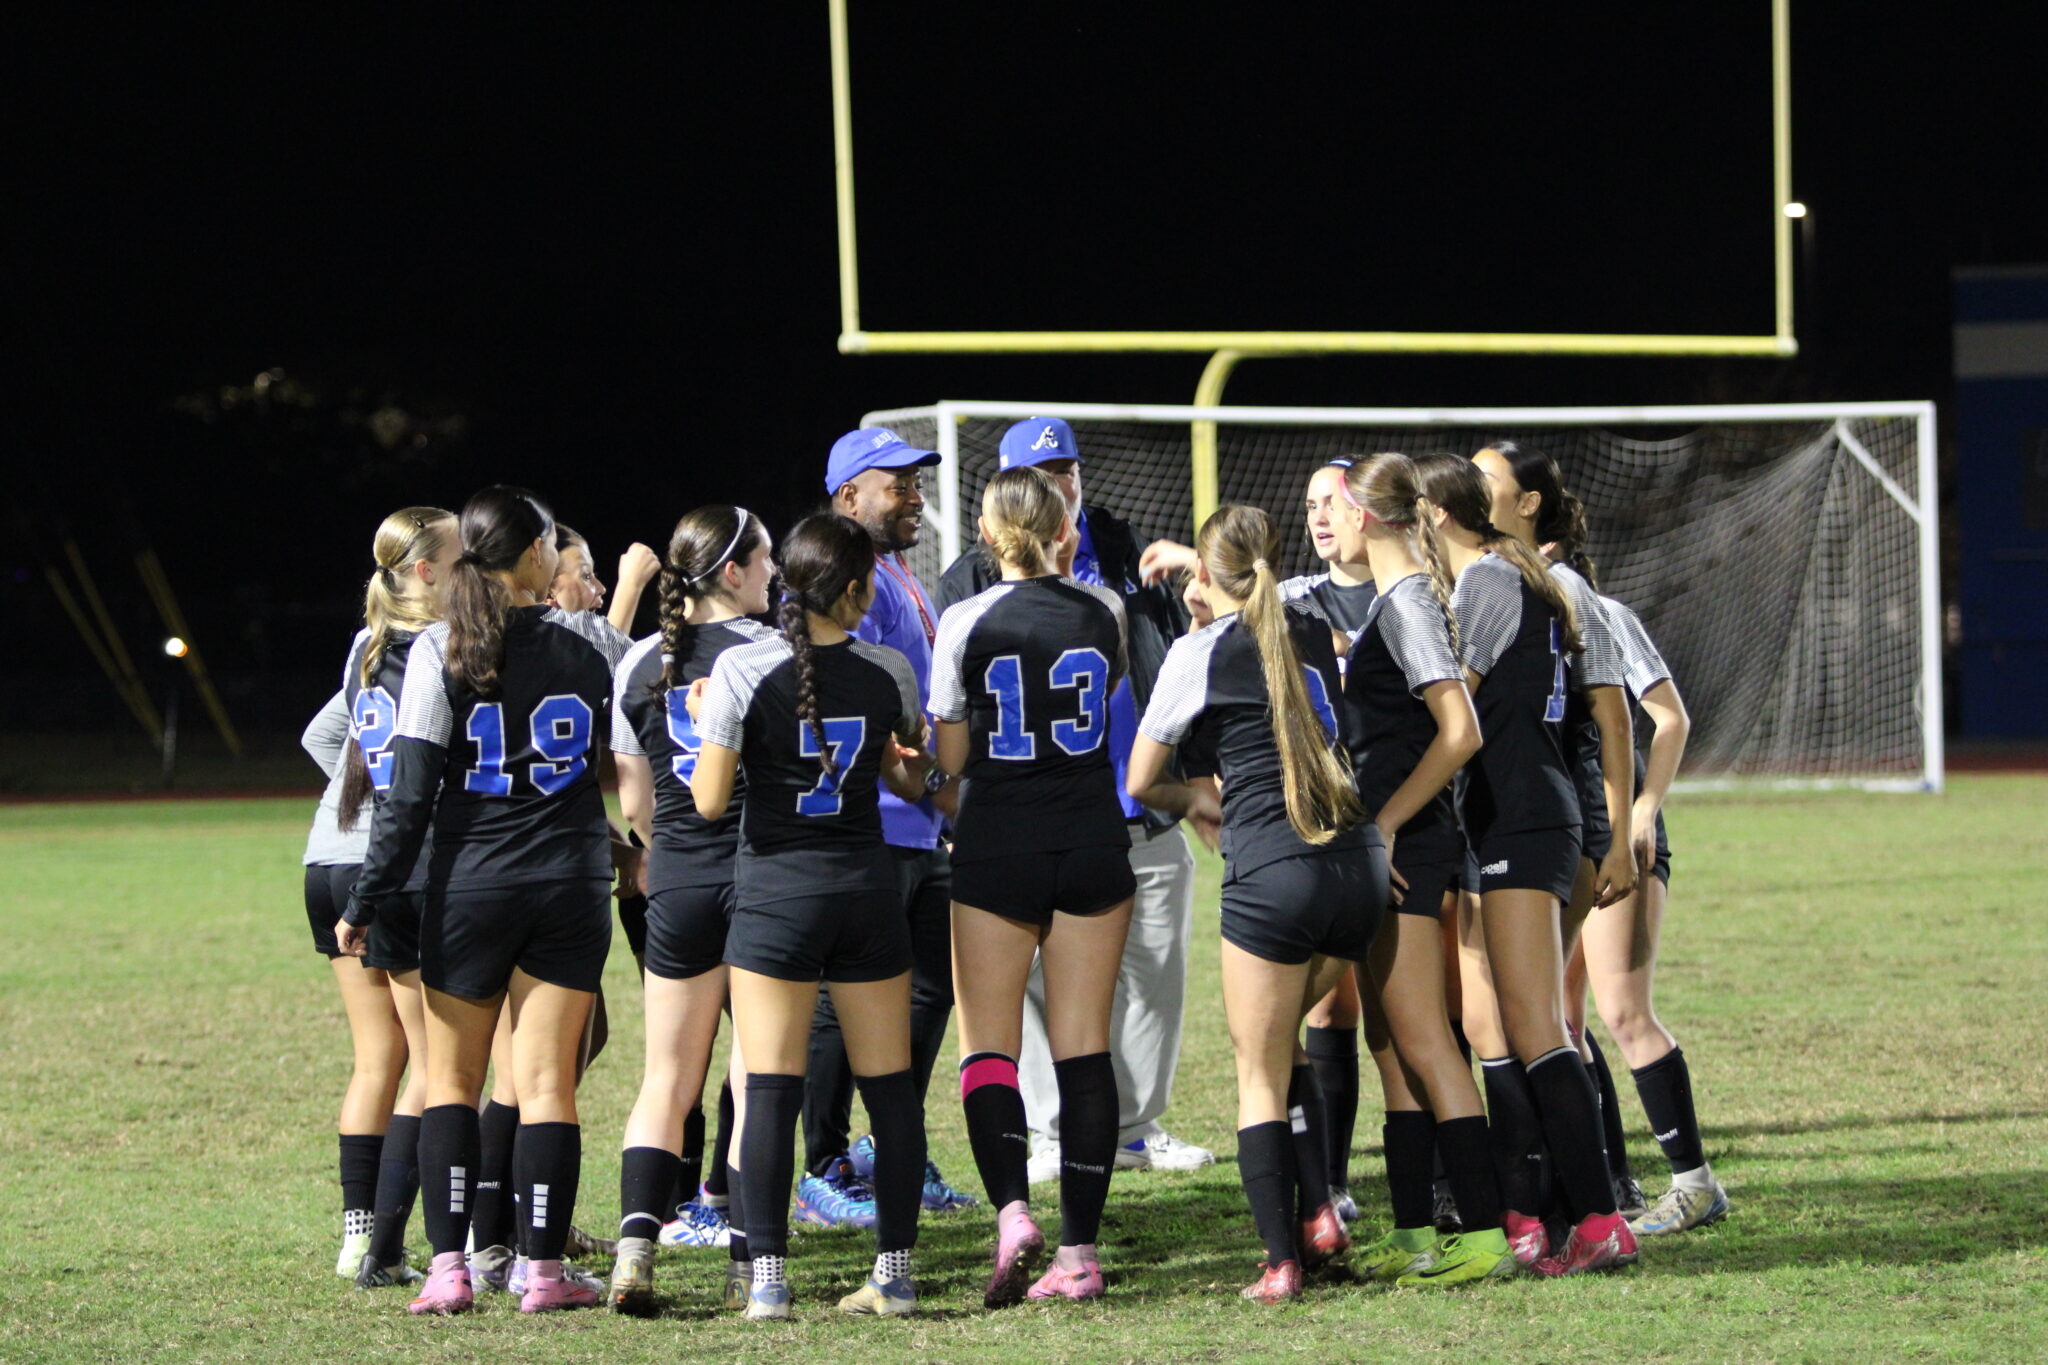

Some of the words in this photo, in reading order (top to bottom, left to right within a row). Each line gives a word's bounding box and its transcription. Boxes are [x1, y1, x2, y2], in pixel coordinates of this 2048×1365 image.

[353, 686, 397, 790] 2
[464, 693, 593, 796] 19
[984, 647, 1109, 760] 13
[796, 716, 866, 817] 7
